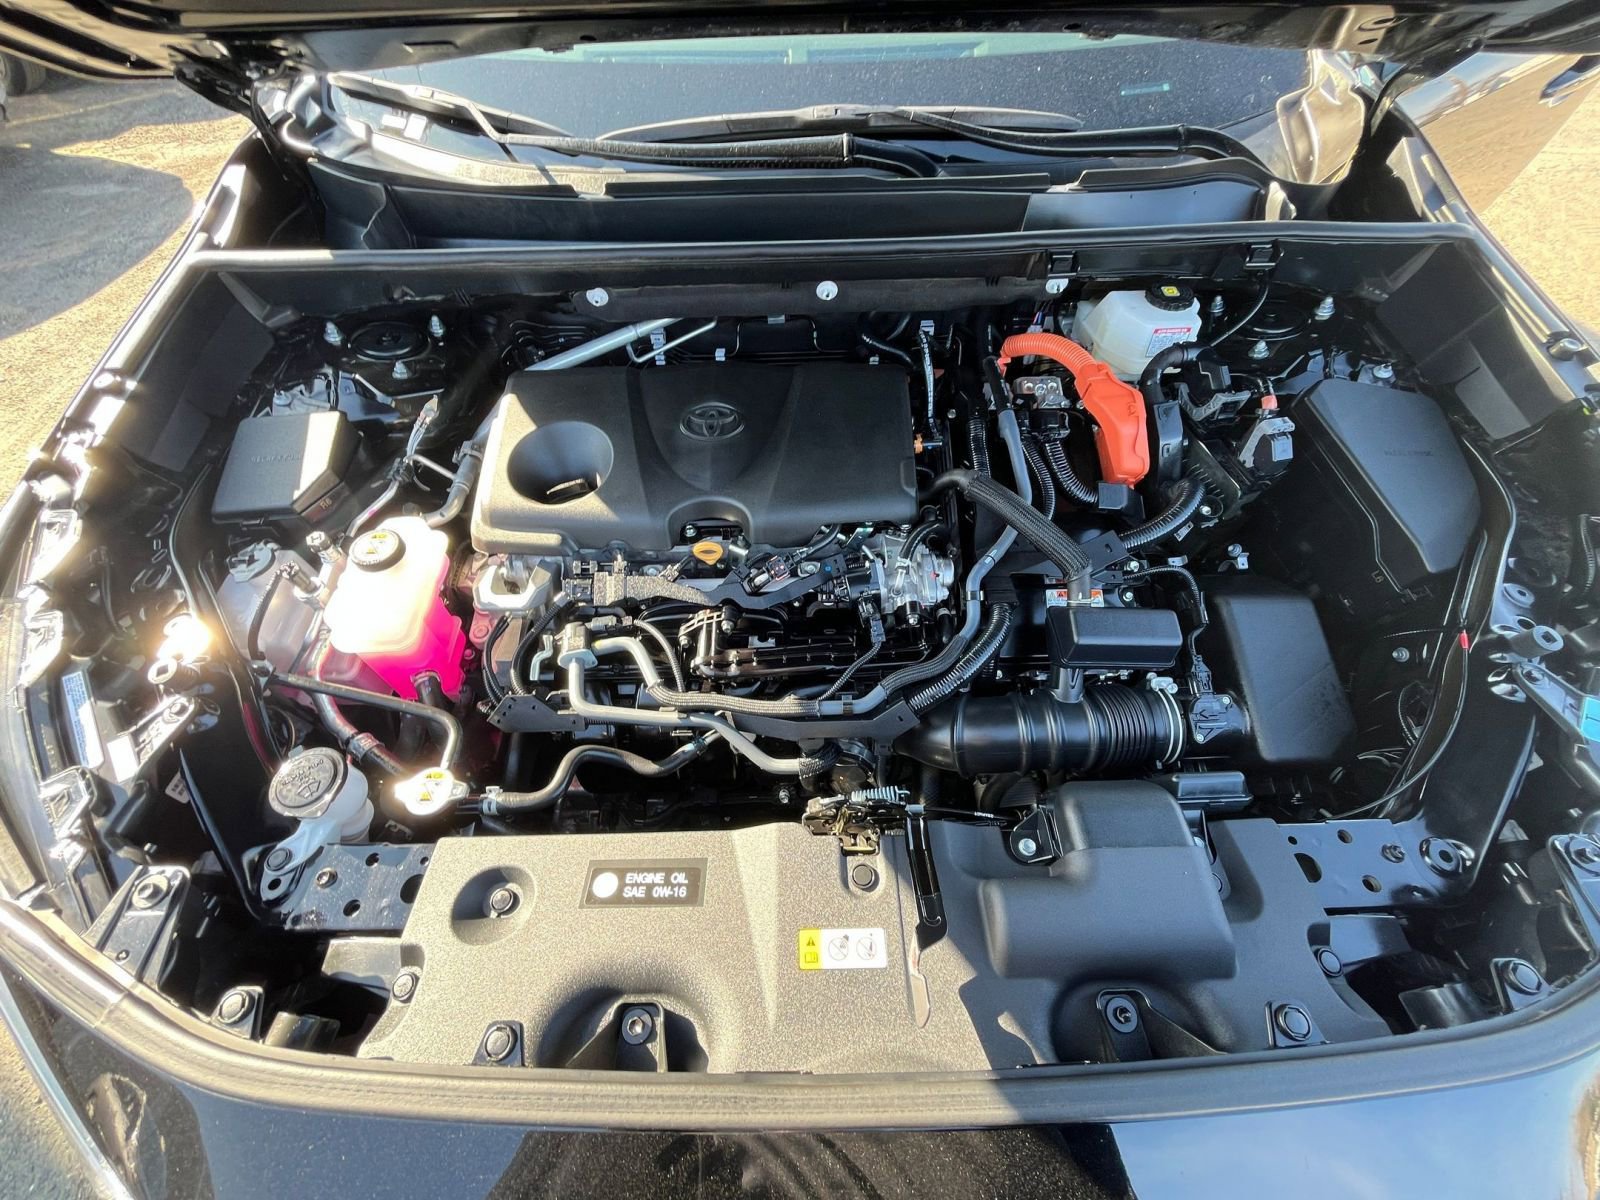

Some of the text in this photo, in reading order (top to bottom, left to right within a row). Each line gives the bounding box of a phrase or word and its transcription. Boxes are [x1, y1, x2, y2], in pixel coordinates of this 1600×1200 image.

[625, 872, 688, 884] ENGINE OIL
[623, 886, 687, 897] SAE 0W-16
